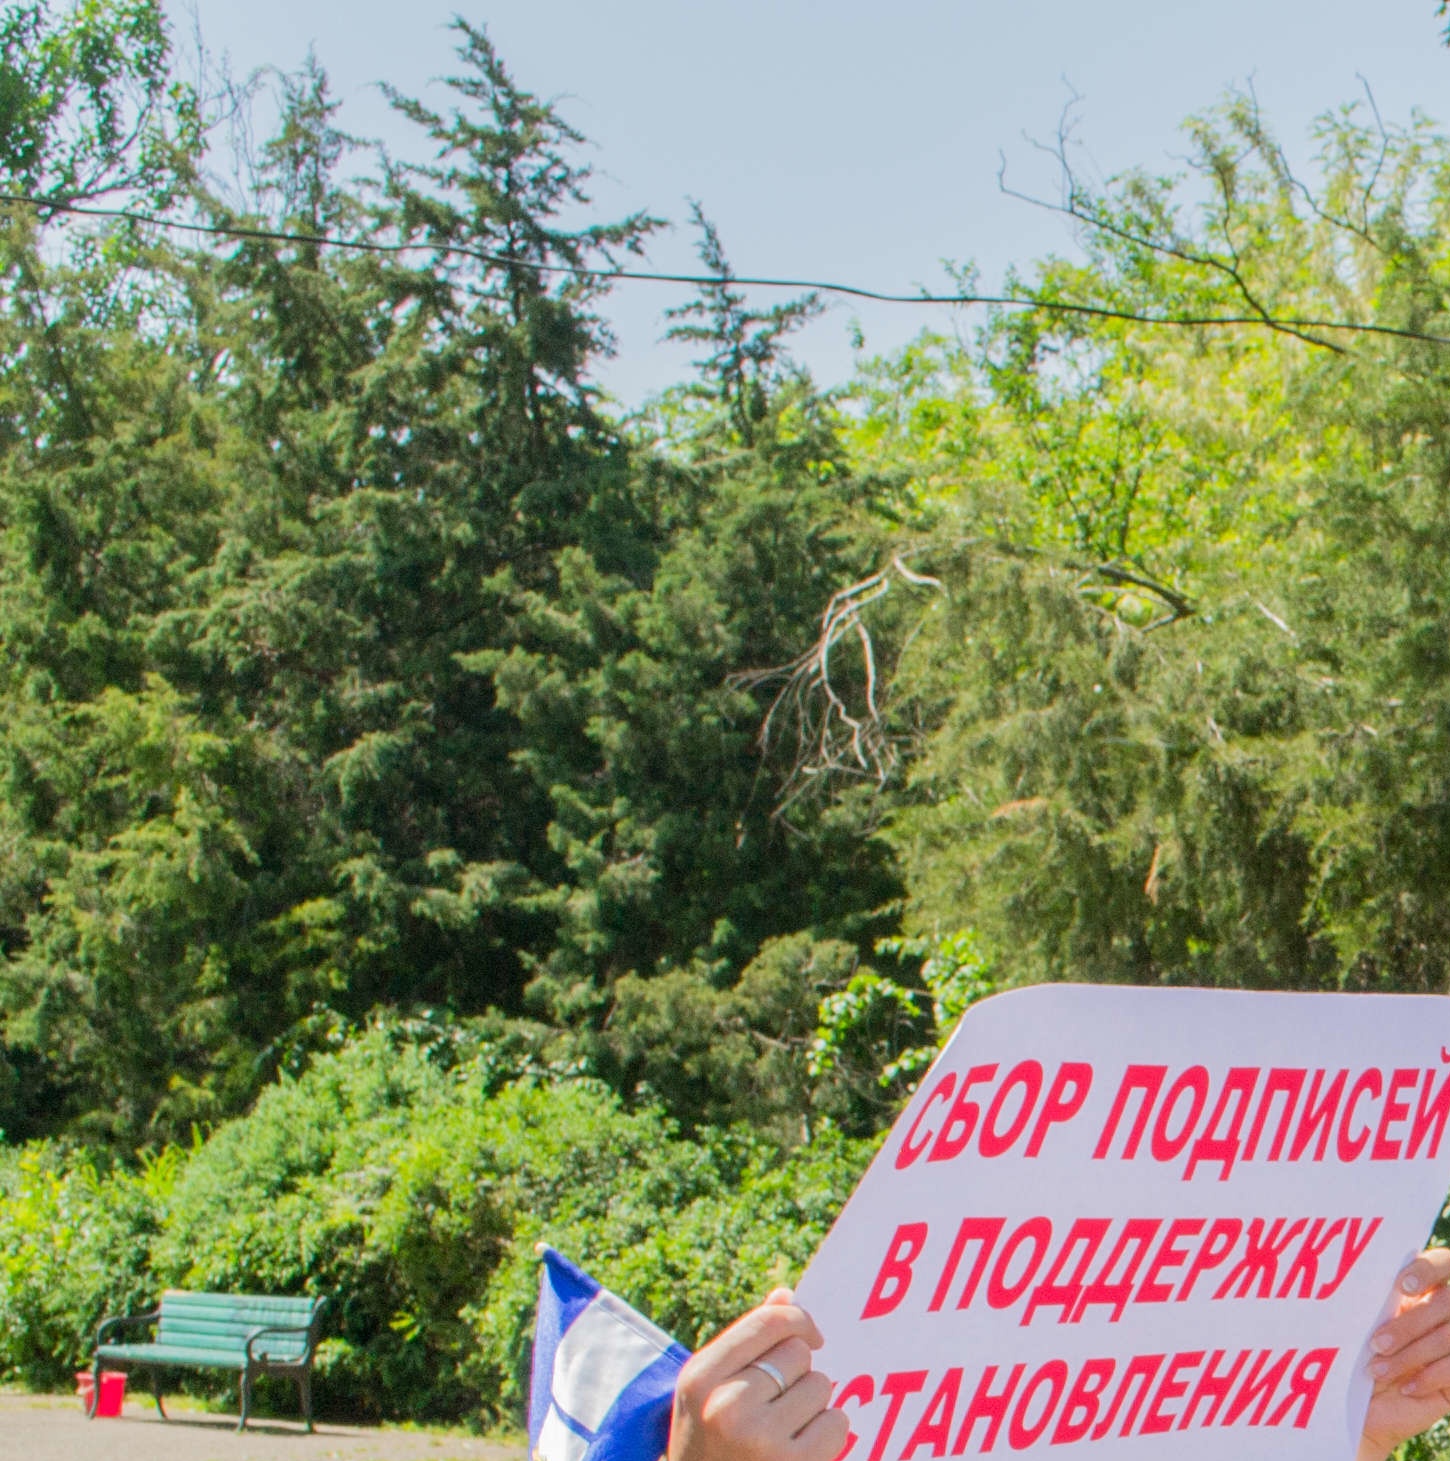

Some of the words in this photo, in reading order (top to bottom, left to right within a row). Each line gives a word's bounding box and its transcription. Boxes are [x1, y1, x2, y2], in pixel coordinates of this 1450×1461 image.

[894, 1058, 1094, 1170] СБОР
[859, 1221, 929, 1321] В
[926, 1216, 1384, 1327] ПОДДЕРЖКУ
